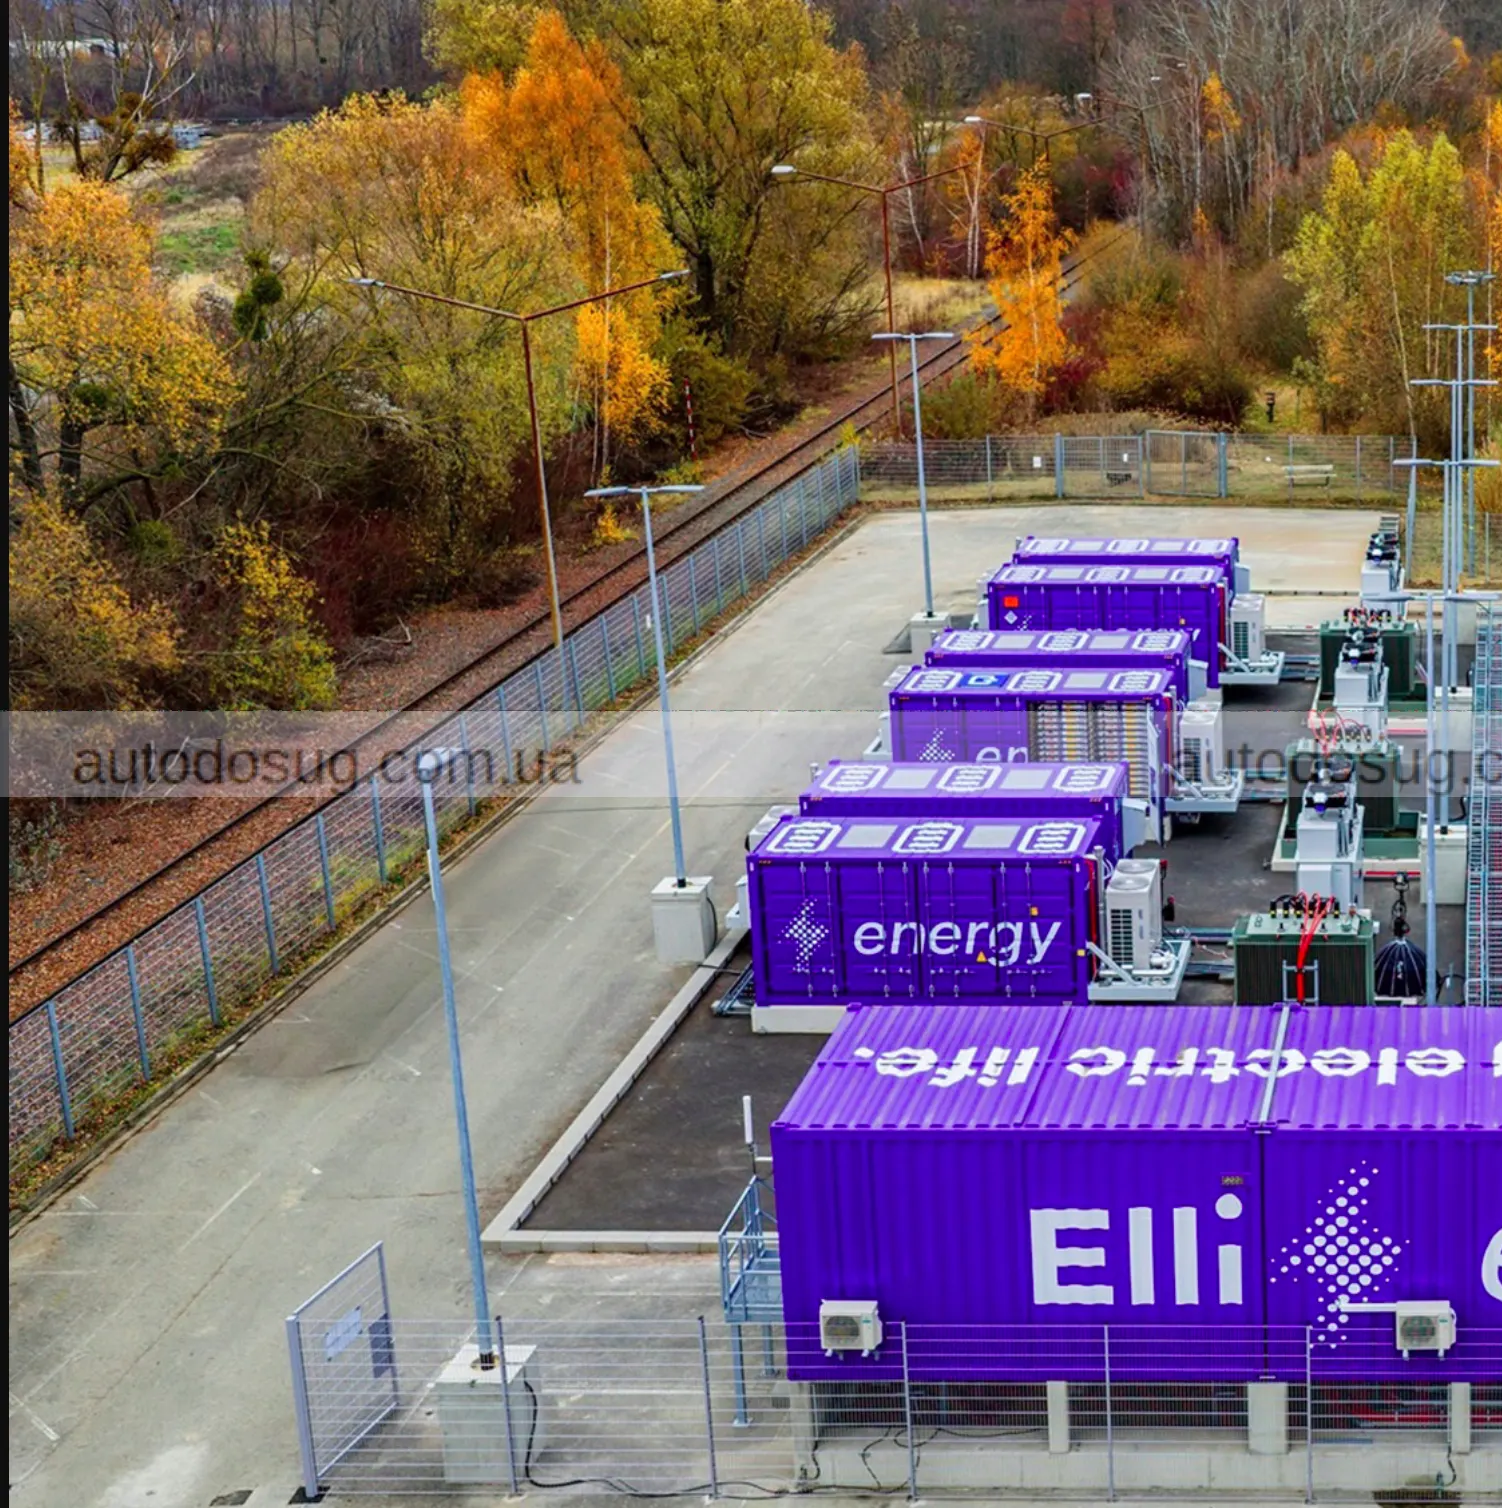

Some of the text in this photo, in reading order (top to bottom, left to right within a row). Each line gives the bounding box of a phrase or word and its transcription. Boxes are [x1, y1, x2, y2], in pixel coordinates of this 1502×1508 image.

[853, 922, 1062, 967] energy
[854, 1046, 1040, 1088] life.
[1066, 1046, 1466, 1087] electric
[1030, 1193, 1243, 1305] Elli
